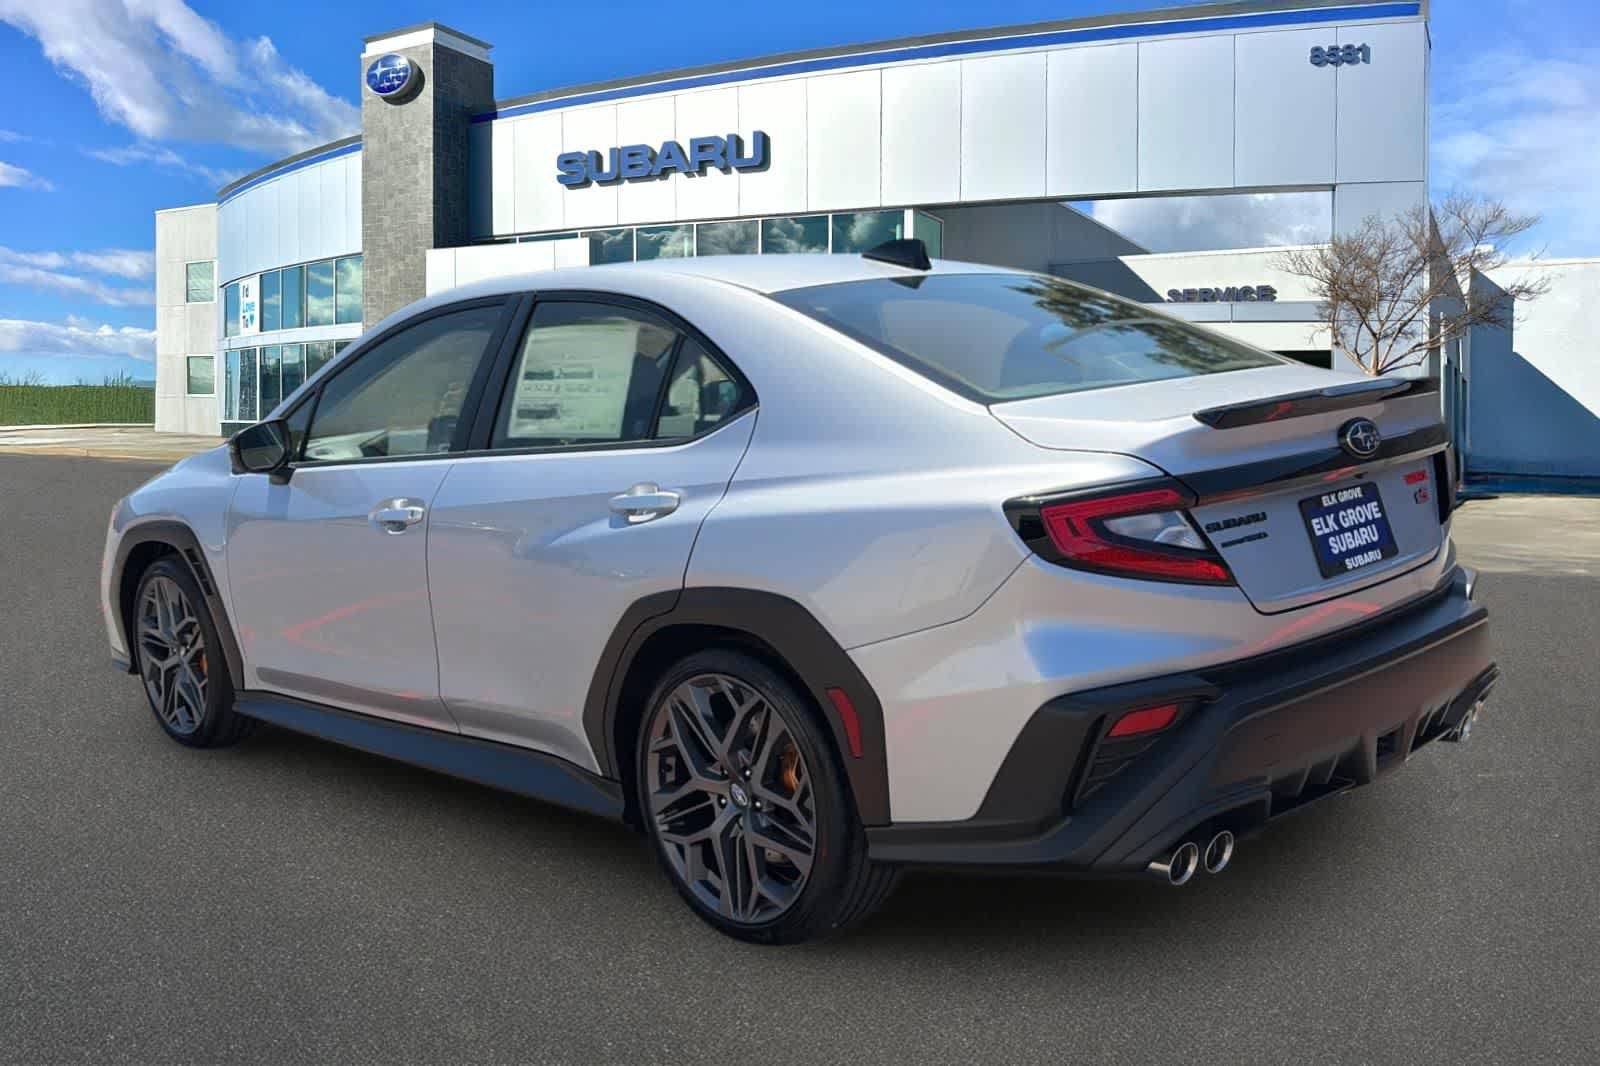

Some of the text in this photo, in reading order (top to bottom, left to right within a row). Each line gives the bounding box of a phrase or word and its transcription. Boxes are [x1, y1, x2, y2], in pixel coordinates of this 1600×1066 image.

[556, 130, 769, 188] SUBARU
[1167, 285, 1277, 302] SERVICE
[1321, 486, 1363, 507] ELK GROVE
[1311, 500, 1382, 536] ELK GROVE
[1328, 524, 1379, 554] SUBARU
[1345, 548, 1382, 570] SUBARU
